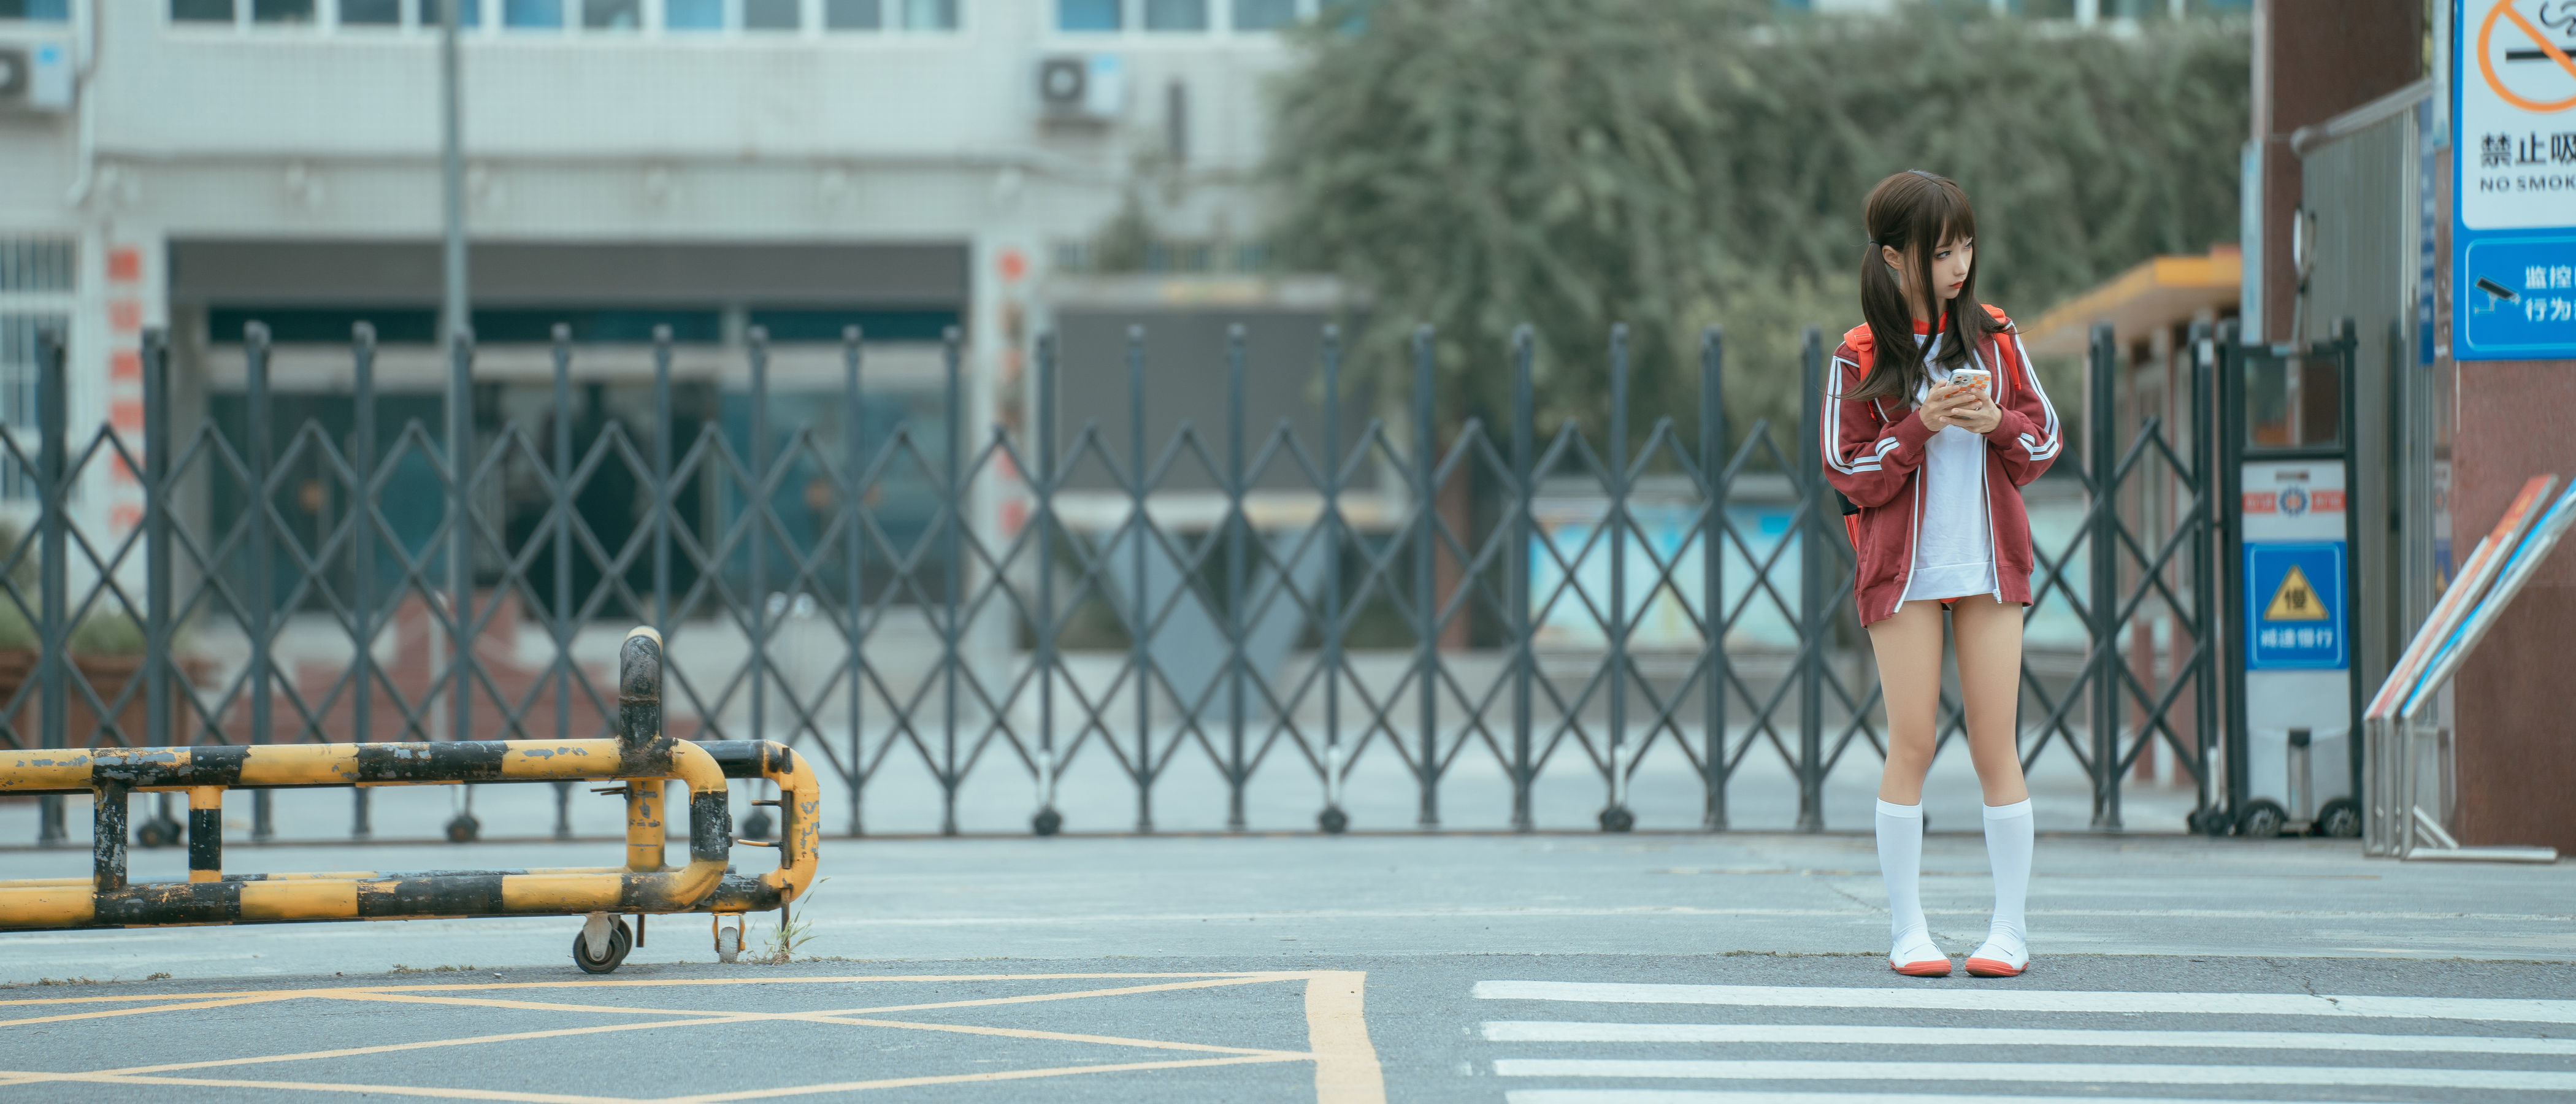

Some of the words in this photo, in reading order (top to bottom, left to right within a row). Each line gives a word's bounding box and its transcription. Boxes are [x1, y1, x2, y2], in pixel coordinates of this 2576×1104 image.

[2481, 131, 2576, 168] 禁止吸
[2480, 176, 2510, 193] NO
[2517, 174, 2576, 191] SMOK
[2526, 265, 2576, 289] 监控
[2526, 297, 2576, 322] 行为
